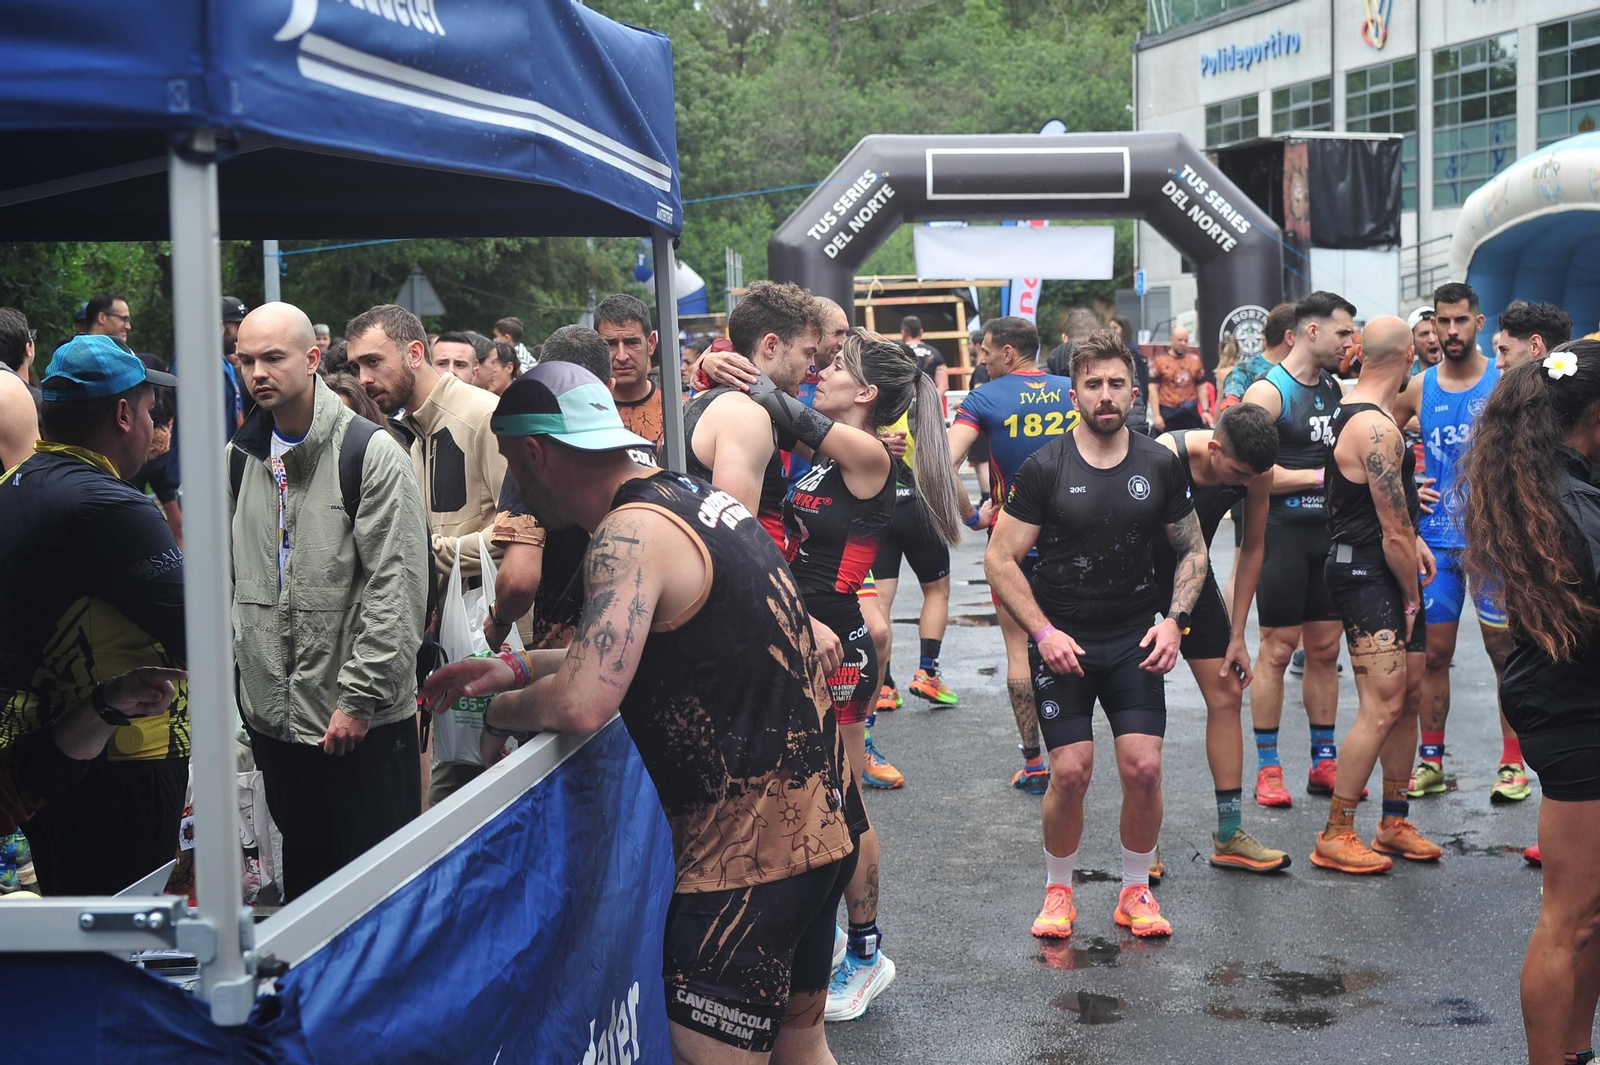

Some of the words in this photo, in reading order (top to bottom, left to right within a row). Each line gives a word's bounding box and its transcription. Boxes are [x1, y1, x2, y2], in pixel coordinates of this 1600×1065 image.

[1200, 30, 1301, 77] Polideportivo
[806, 210, 838, 241] TUS
[832, 168, 877, 217] SERIES
[1161, 179, 1190, 211] DEL
[1187, 204, 1238, 253] NORTE
[1180, 163, 1209, 195] TUS
[1204, 189, 1252, 234] SERIES
[823, 231, 854, 259] DEL
[848, 183, 896, 234] NORTE
[1020, 387, 1061, 404] IVÁN
[1004, 409, 1081, 438] 1822
[827, 675, 859, 686] BULLS
[833, 666, 860, 677] RAVE
[676, 989, 771, 1031] CAVERNÍCOLA
[691, 1009, 717, 1028] OCR
[719, 1020, 754, 1041] TEAM
